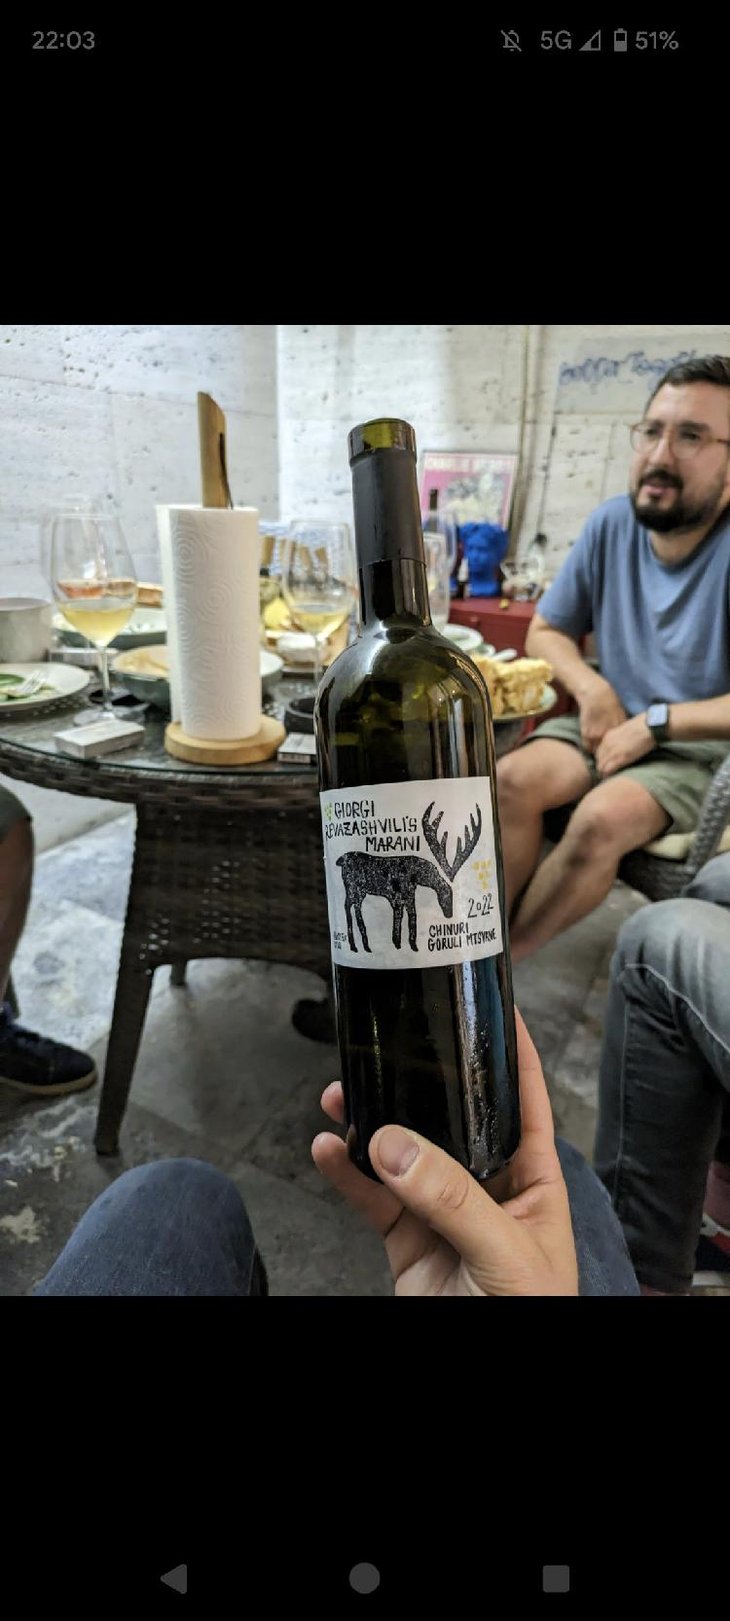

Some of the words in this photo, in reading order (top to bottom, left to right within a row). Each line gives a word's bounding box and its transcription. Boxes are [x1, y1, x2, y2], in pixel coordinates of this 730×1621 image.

[334, 799, 375, 819] GIORGI
[365, 835, 420, 852] MARANI
[467, 893, 494, 918] 2022
[428, 921, 469, 938] CHINURI
[427, 935, 462, 952] GORULI
